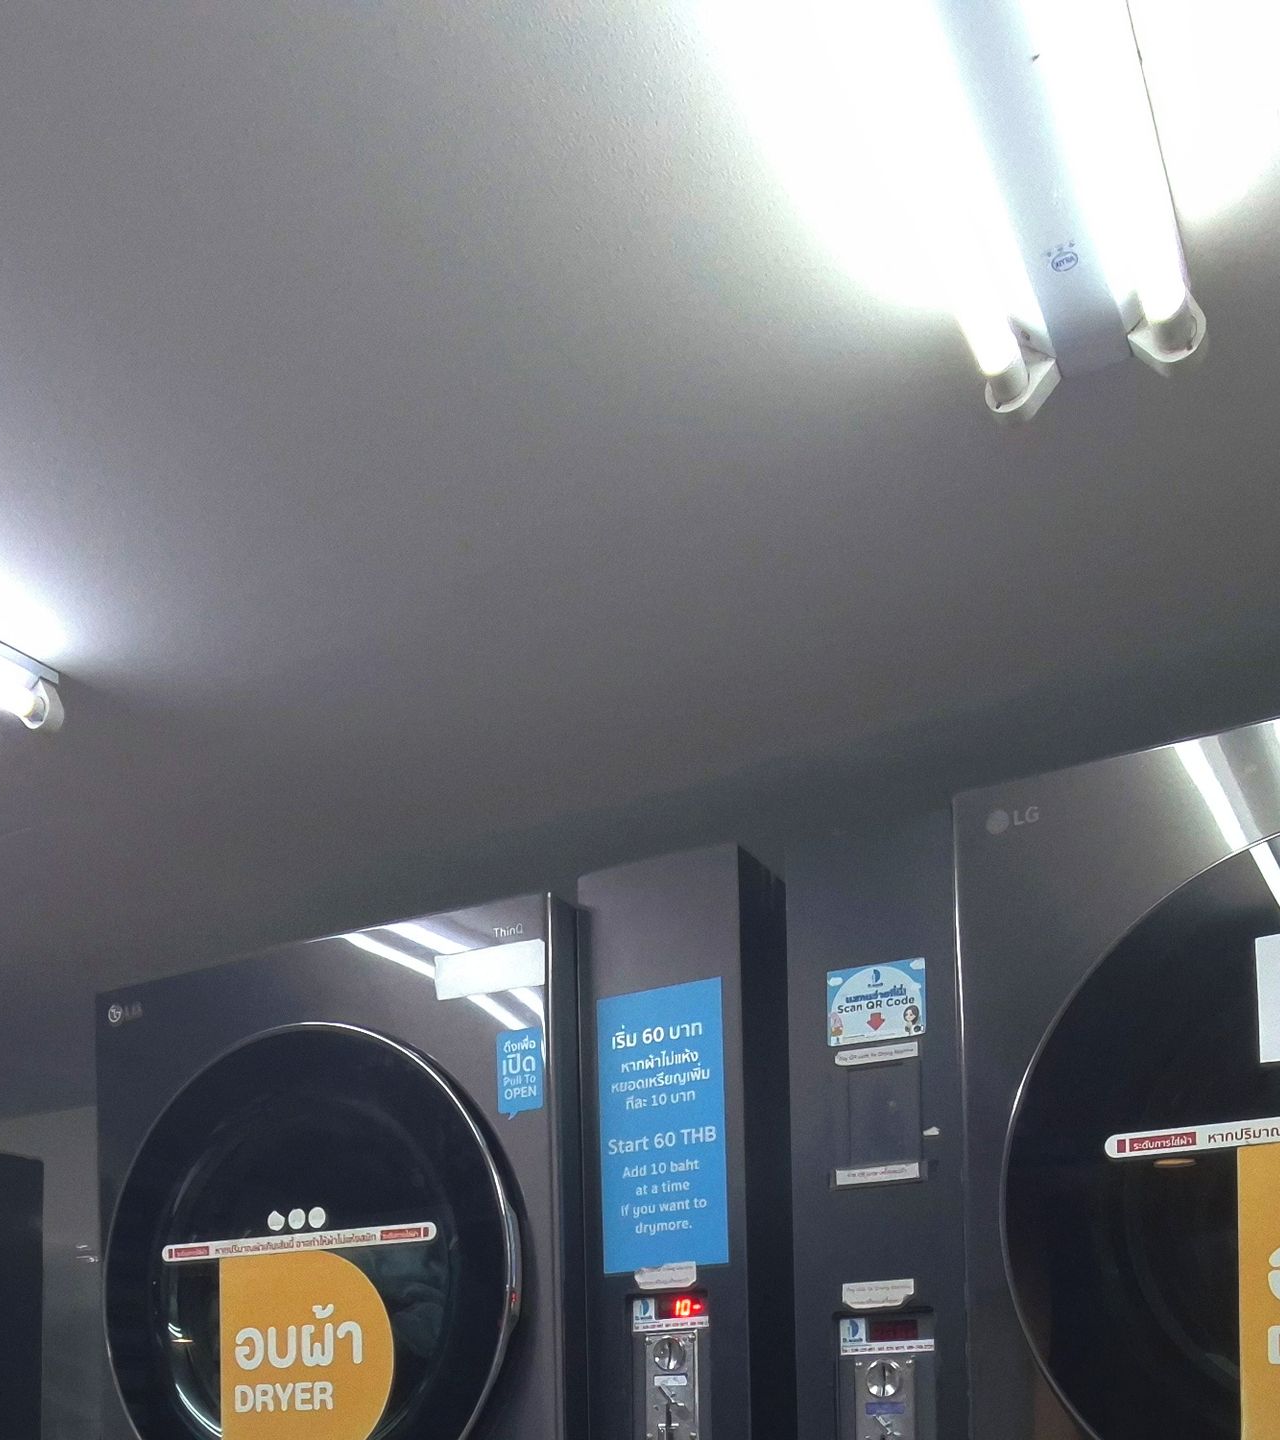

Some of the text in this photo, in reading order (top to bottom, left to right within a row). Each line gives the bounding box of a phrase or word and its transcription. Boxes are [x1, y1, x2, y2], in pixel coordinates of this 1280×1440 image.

[1013, 806, 1040, 825] LG
[837, 995, 915, 1014] Scan QR Code
[612, 1022, 702, 1050] เริ่ม 60 บาท
[503, 1053, 536, 1075] เปิด
[503, 1075, 521, 1087] Pull
[504, 1085, 536, 1100] OPEN
[651, 1093, 666, 1107] 10
[670, 1090, 695, 1105] บาท
[608, 1126, 717, 1155] Start 60 THB
[622, 1159, 700, 1179] Add 10 baht
[635, 1181, 690, 1196] at a time
[633, 1203, 656, 1218] you
[659, 1199, 690, 1212] want
[694, 1198, 707, 1209] to
[635, 1219, 693, 1236] drymore.
[234, 1304, 362, 1370] อบผ้า
[234, 1381, 334, 1413] DRYER
